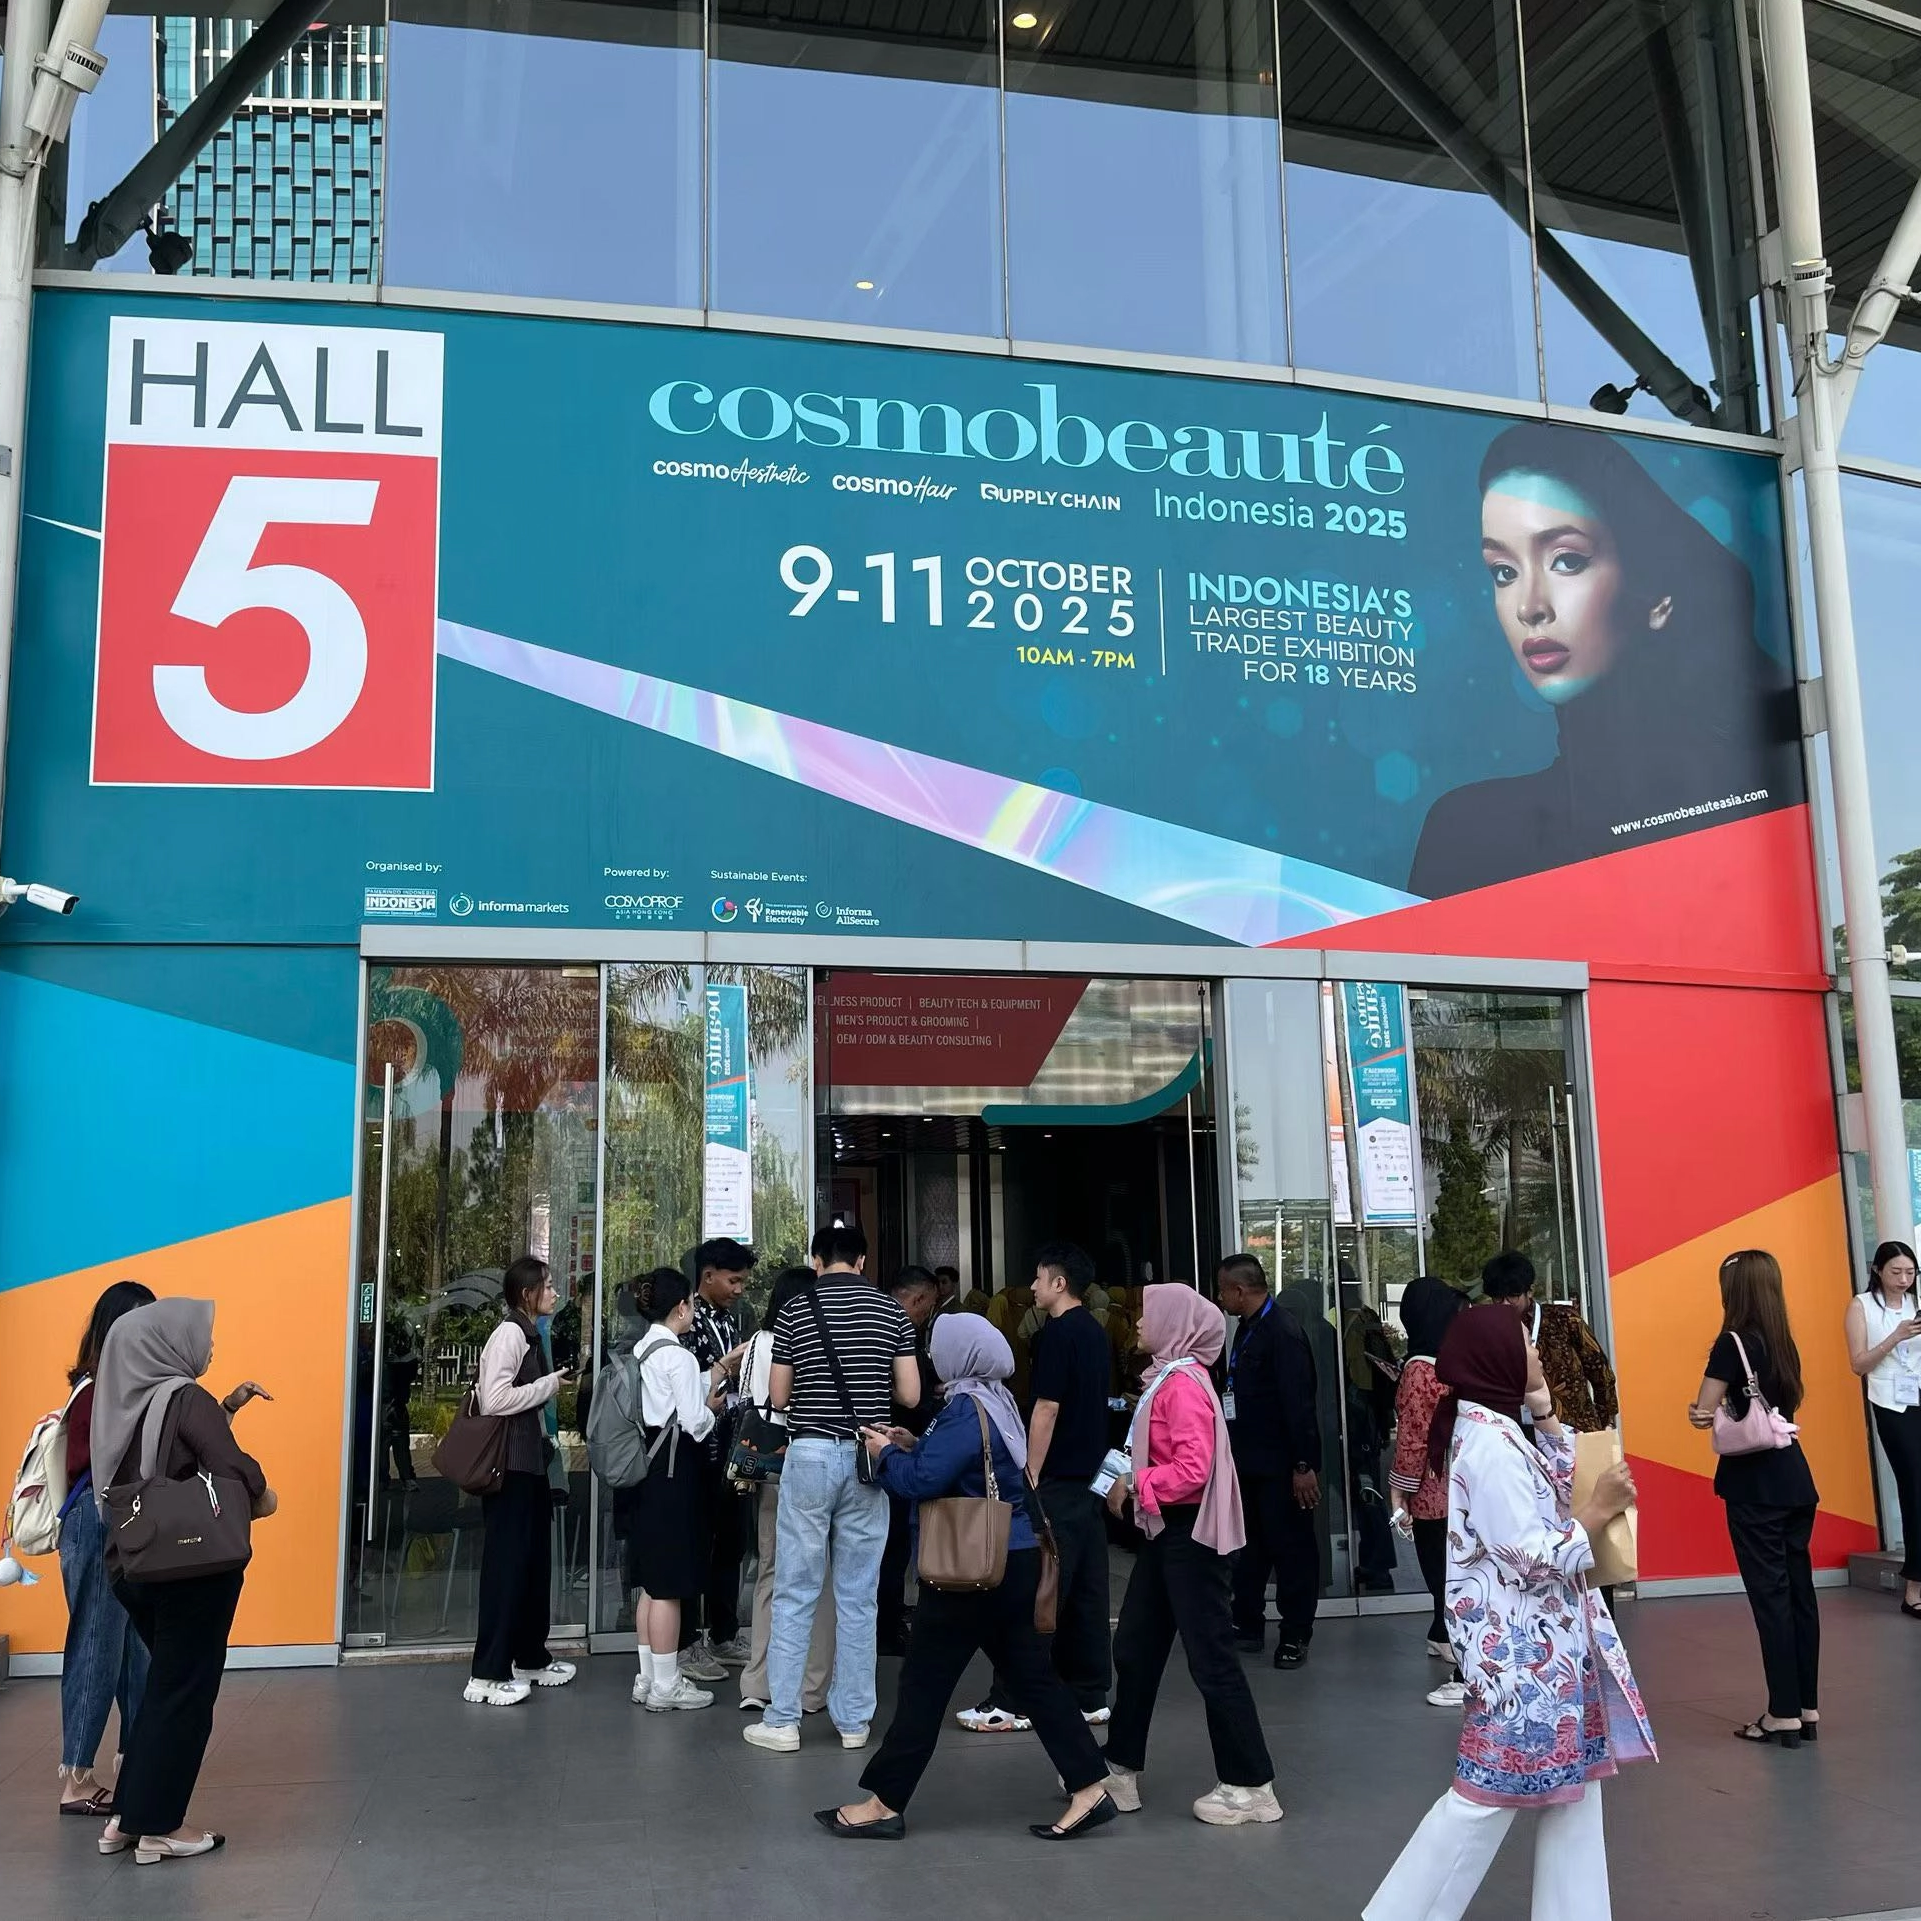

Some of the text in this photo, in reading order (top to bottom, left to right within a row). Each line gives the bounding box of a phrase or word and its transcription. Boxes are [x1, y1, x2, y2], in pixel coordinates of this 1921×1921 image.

[130, 338, 422, 437] HALL
[649, 381, 1405, 495] cosmobeauté
[980, 483, 1121, 511] SUPPLY CHAIN
[1154, 487, 1407, 540] Indonesia 2025
[965, 556, 1133, 595] OCTOBER
[780, 545, 945, 627] 9-11
[1188, 571, 1412, 618] INDONESIA'S
[152, 475, 381, 762] 5
[1189, 605, 1414, 642] LARGEST BEAUTY
[1017, 646, 1075, 666] 10AM
[1092, 649, 1135, 669] 7PM
[1190, 630, 1415, 668] TRADE EXHIBITION
[1244, 658, 1416, 693] FOR 18 YEARS
[1611, 788, 1768, 836] www.cosmobeauteasia.com
[366, 861, 442, 874] Organised by:
[604, 867, 670, 880] Powered by:
[711, 870, 808, 883] Sustainable Events:
[366, 897, 435, 911] INDONESIA
[605, 895, 684, 908] COSMOPROF
[765, 908, 809, 916] Renewable
[765, 916, 805, 925] Electricity
[836, 907, 872, 916] Informa
[836, 916, 879, 925] AllSecure
[860, 996, 902, 1008] PRODUCT
[919, 998, 1041, 1010] BEAUTY TECH & EQUIPMENT
[836, 1015, 969, 1028] MEN'S PRODUCT & GROOMING
[837, 1033, 857, 1044] OEM
[866, 1034, 886, 1045] ODM
[889, 1035, 896, 1045] &
[899, 1035, 934, 1046] BEAUTY
[936, 1035, 992, 1046] CONSULTING
